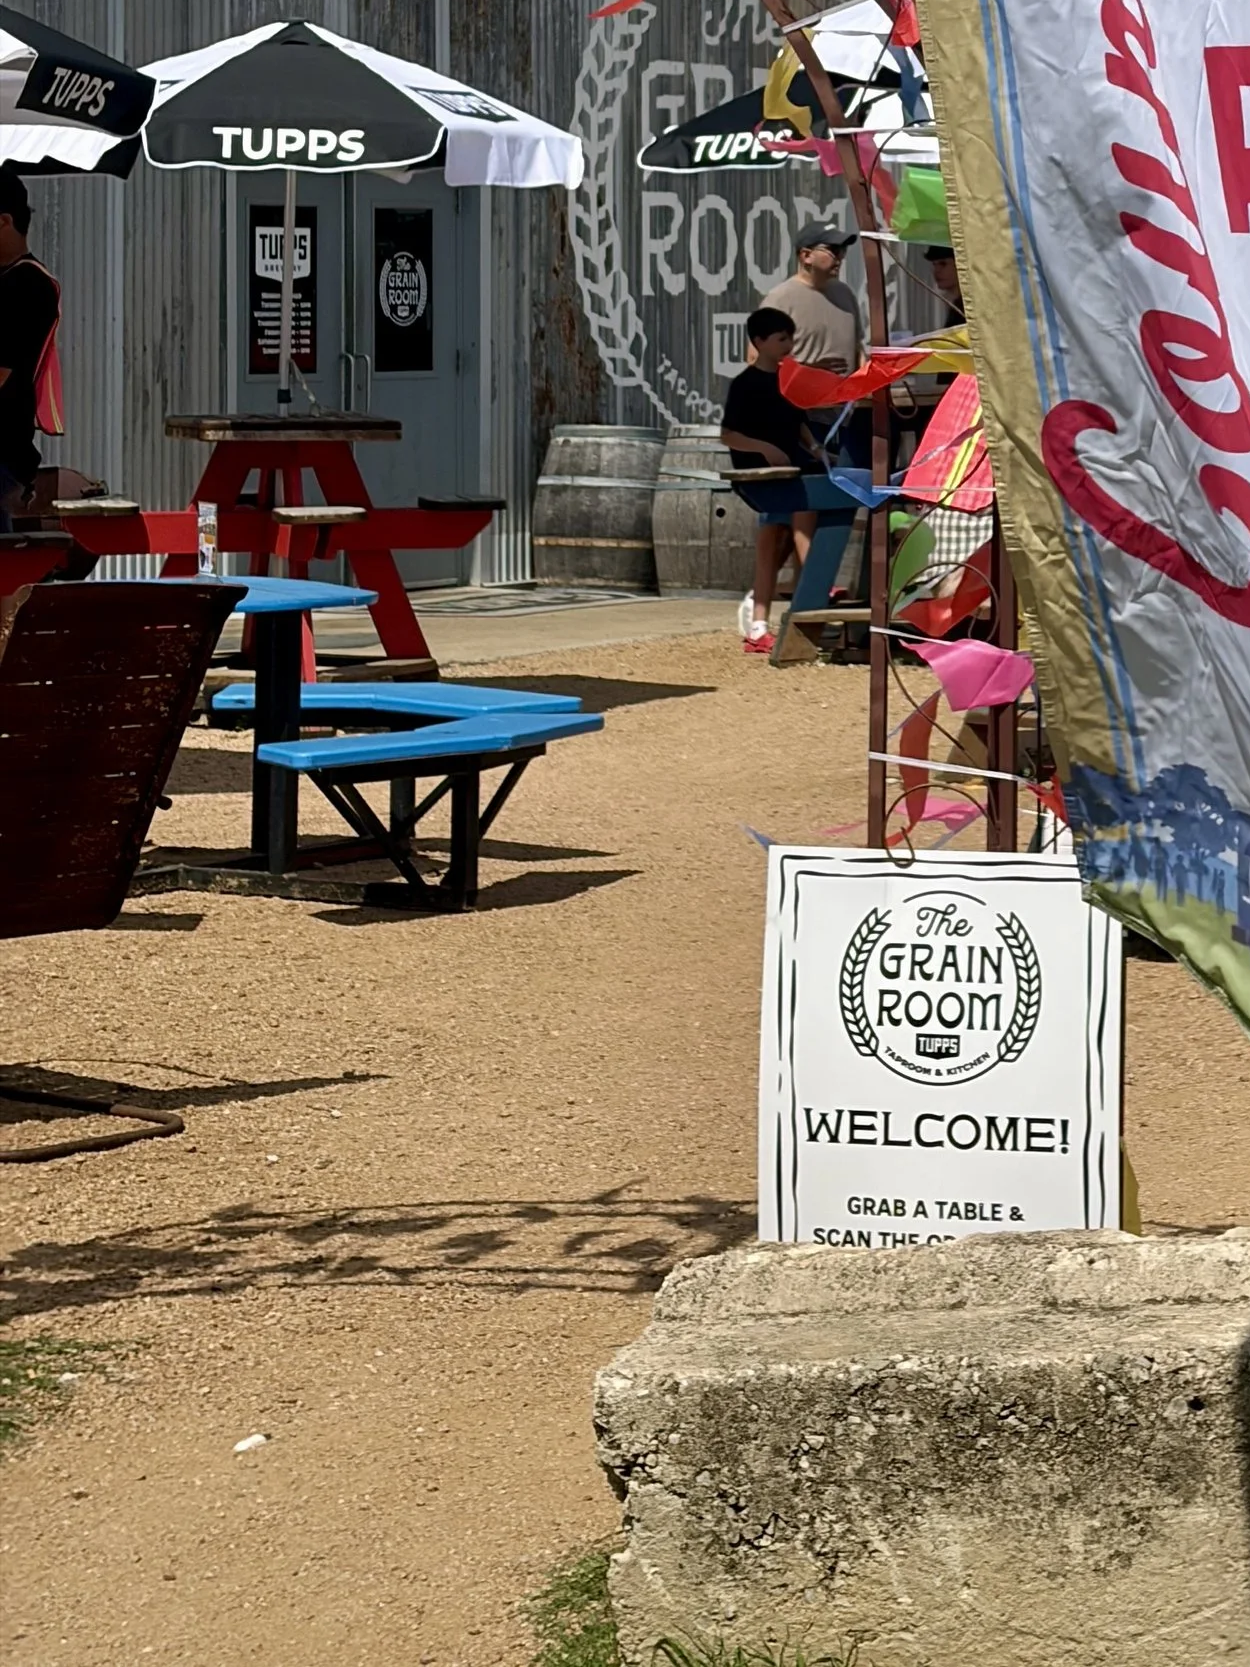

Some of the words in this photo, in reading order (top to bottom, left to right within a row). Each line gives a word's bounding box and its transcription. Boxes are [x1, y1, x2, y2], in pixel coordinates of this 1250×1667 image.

[42, 66, 115, 117] TUPPS
[212, 126, 366, 162] TUPPS
[388, 272, 419, 288] GRAIN
[388, 289, 419, 305] ROOM
[915, 902, 974, 937] The
[879, 942, 1004, 984] GRAIN
[876, 988, 1003, 1031] ROOM
[884, 1045, 932, 1076] TAPROOM
[934, 1068, 943, 1076] &
[945, 1051, 991, 1076] KITCHEN
[918, 1037, 959, 1054] TUPPS
[802, 1106, 1070, 1154] WELCOME!
[847, 1196, 907, 1218] GRAB
[912, 1200, 929, 1219] A
[934, 1200, 1004, 1222] TABLE
[1008, 1206, 1026, 1222] &
[812, 1227, 872, 1249] SCAN
